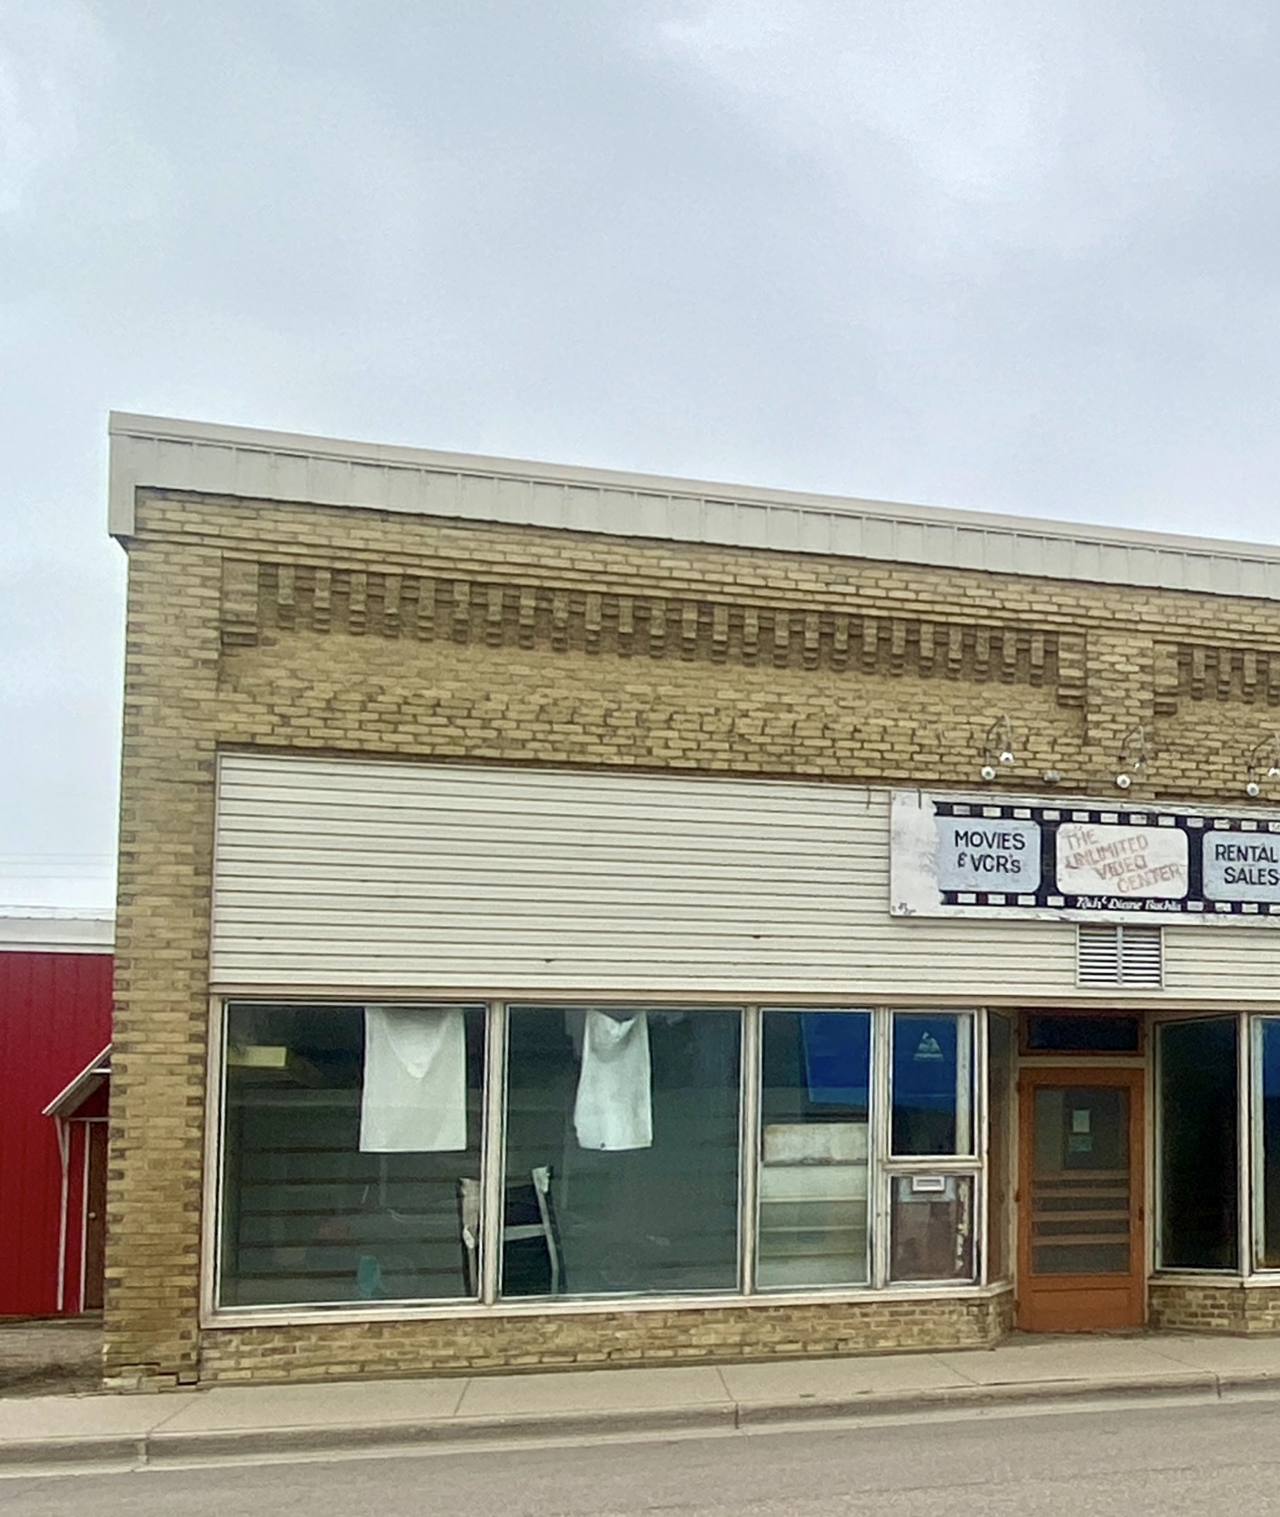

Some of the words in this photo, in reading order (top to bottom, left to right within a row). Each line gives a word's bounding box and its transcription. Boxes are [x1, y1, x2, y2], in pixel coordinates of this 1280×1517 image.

[954, 830, 1026, 851] MOVIES
[1067, 829, 1099, 850] THE
[1065, 835, 1148, 869] UNLIMITED
[1215, 844, 1278, 863] RENTAL
[971, 853, 1021, 874] VCR's
[1095, 854, 1148, 880] VIDEO
[1117, 863, 1182, 893] CENTER
[1224, 867, 1280, 886] SALES
